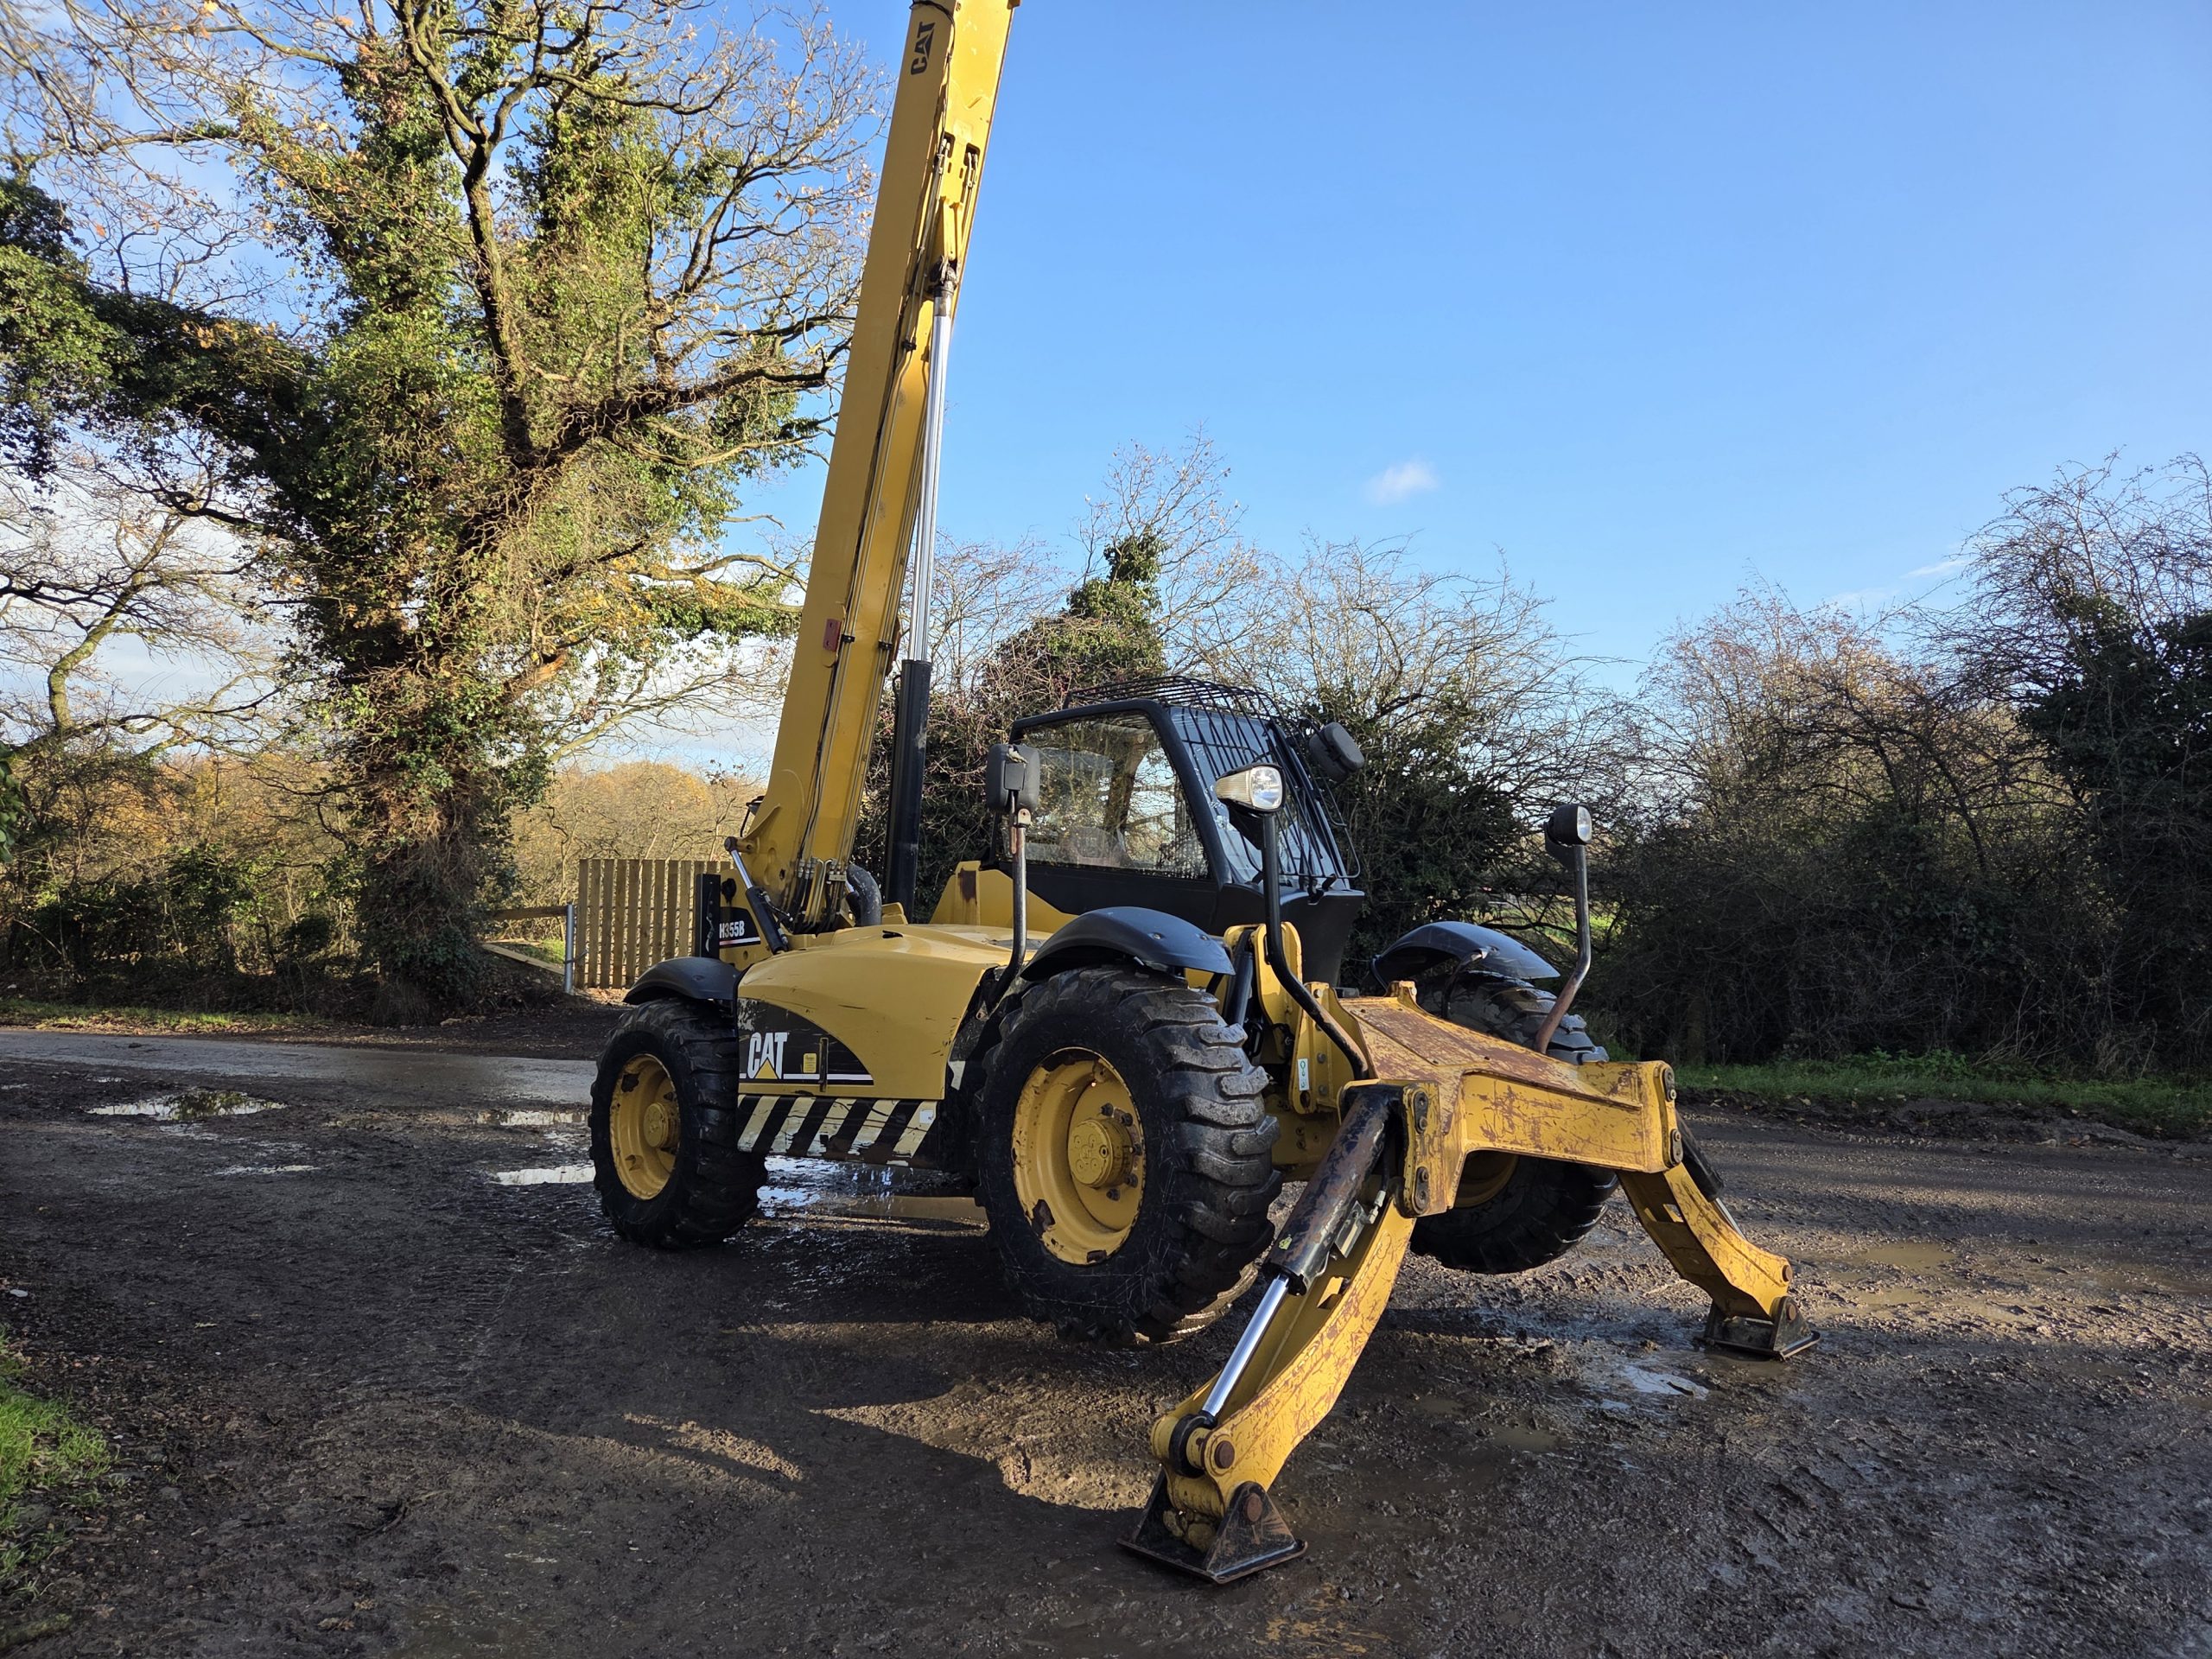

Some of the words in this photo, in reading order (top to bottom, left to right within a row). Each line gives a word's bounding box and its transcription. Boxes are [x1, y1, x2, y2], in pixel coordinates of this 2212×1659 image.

[911, 21, 936, 75] CAT
[719, 920, 745, 939] H355B
[747, 1032, 788, 1079] CAT
